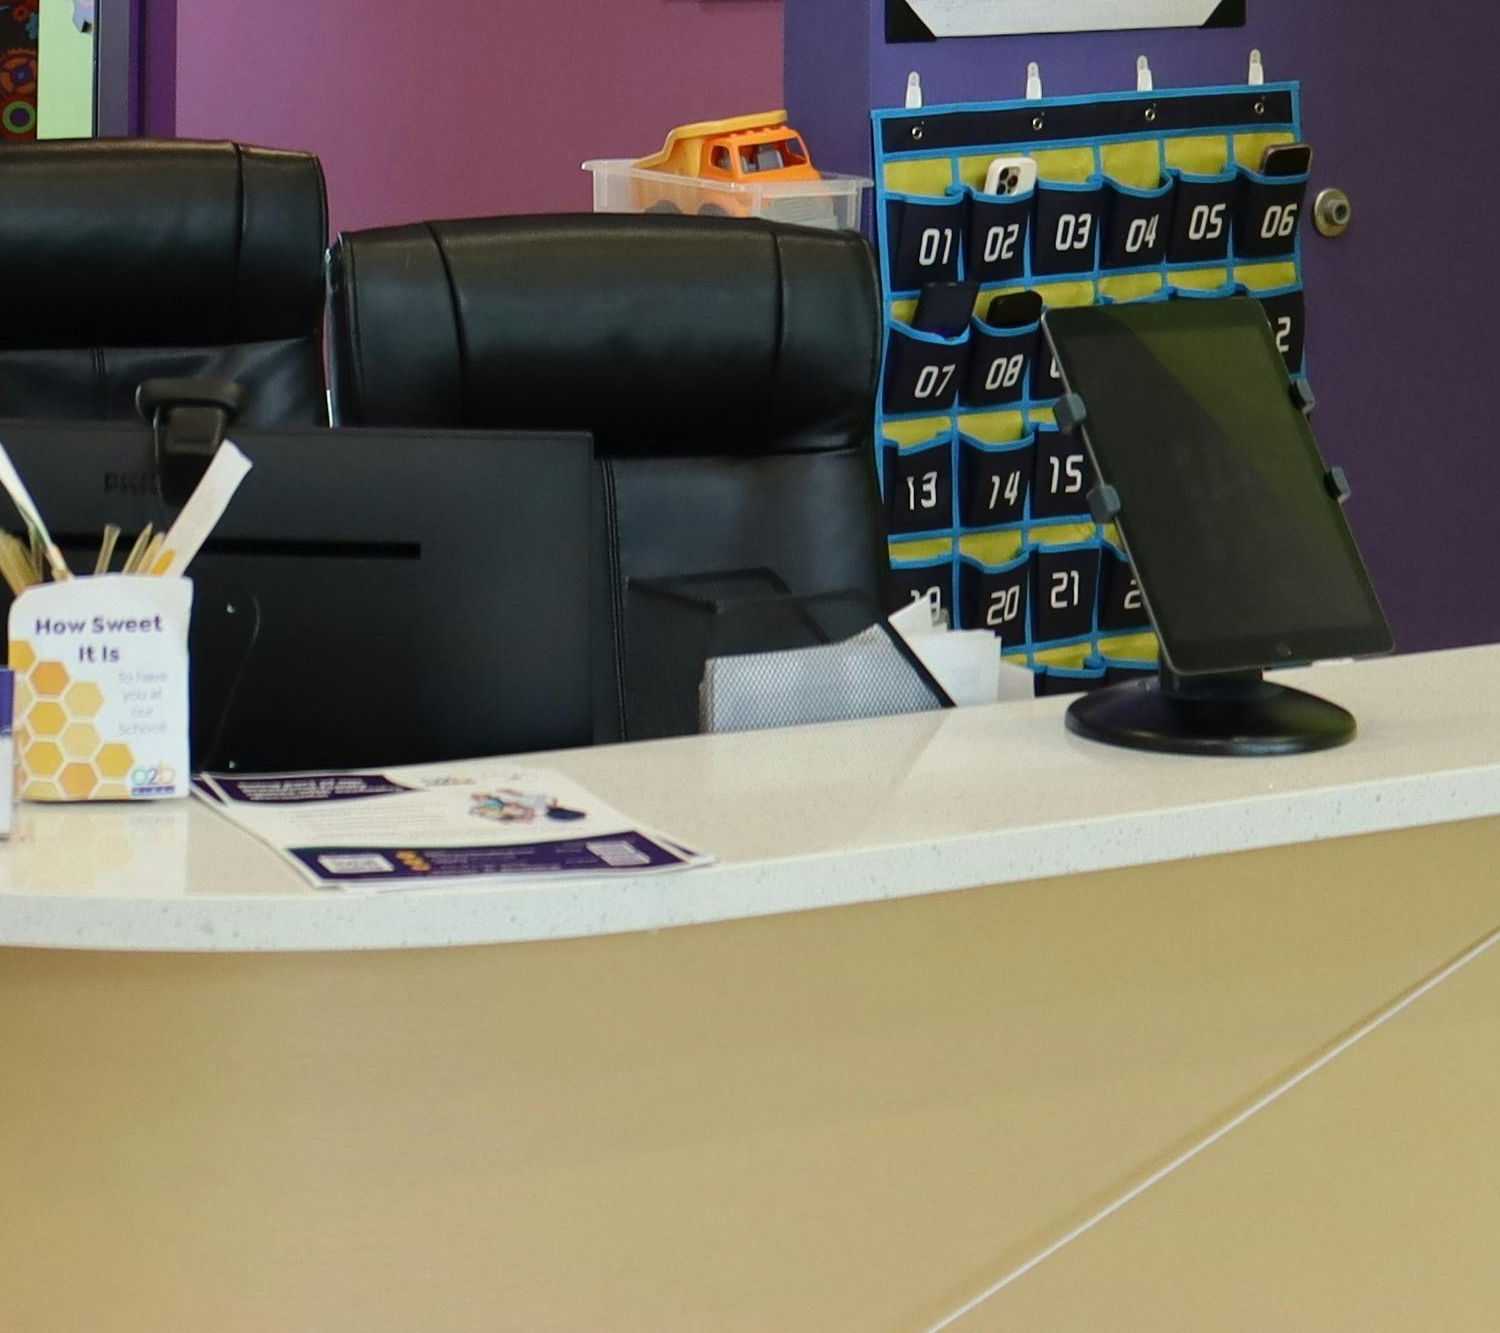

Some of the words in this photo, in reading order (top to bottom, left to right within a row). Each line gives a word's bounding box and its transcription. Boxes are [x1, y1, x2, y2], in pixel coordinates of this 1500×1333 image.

[1055, 213, 1091, 251] 03
[1125, 213, 1159, 254] 04
[1188, 203, 1226, 241] 05
[1261, 203, 1298, 240] 06
[918, 228, 952, 267] 01
[983, 224, 1019, 264] 02
[915, 364, 955, 399] 07
[985, 354, 1024, 391] 08
[906, 469, 938, 510] 13
[988, 469, 1021, 509] 14
[1049, 453, 1084, 494] 15
[986, 585, 1020, 626] 20
[1051, 570, 1080, 610] 21
[35, 617, 86, 635] How
[92, 614, 163, 634] Sweet
[79, 646, 95, 662] It
[102, 645, 120, 662] Is
